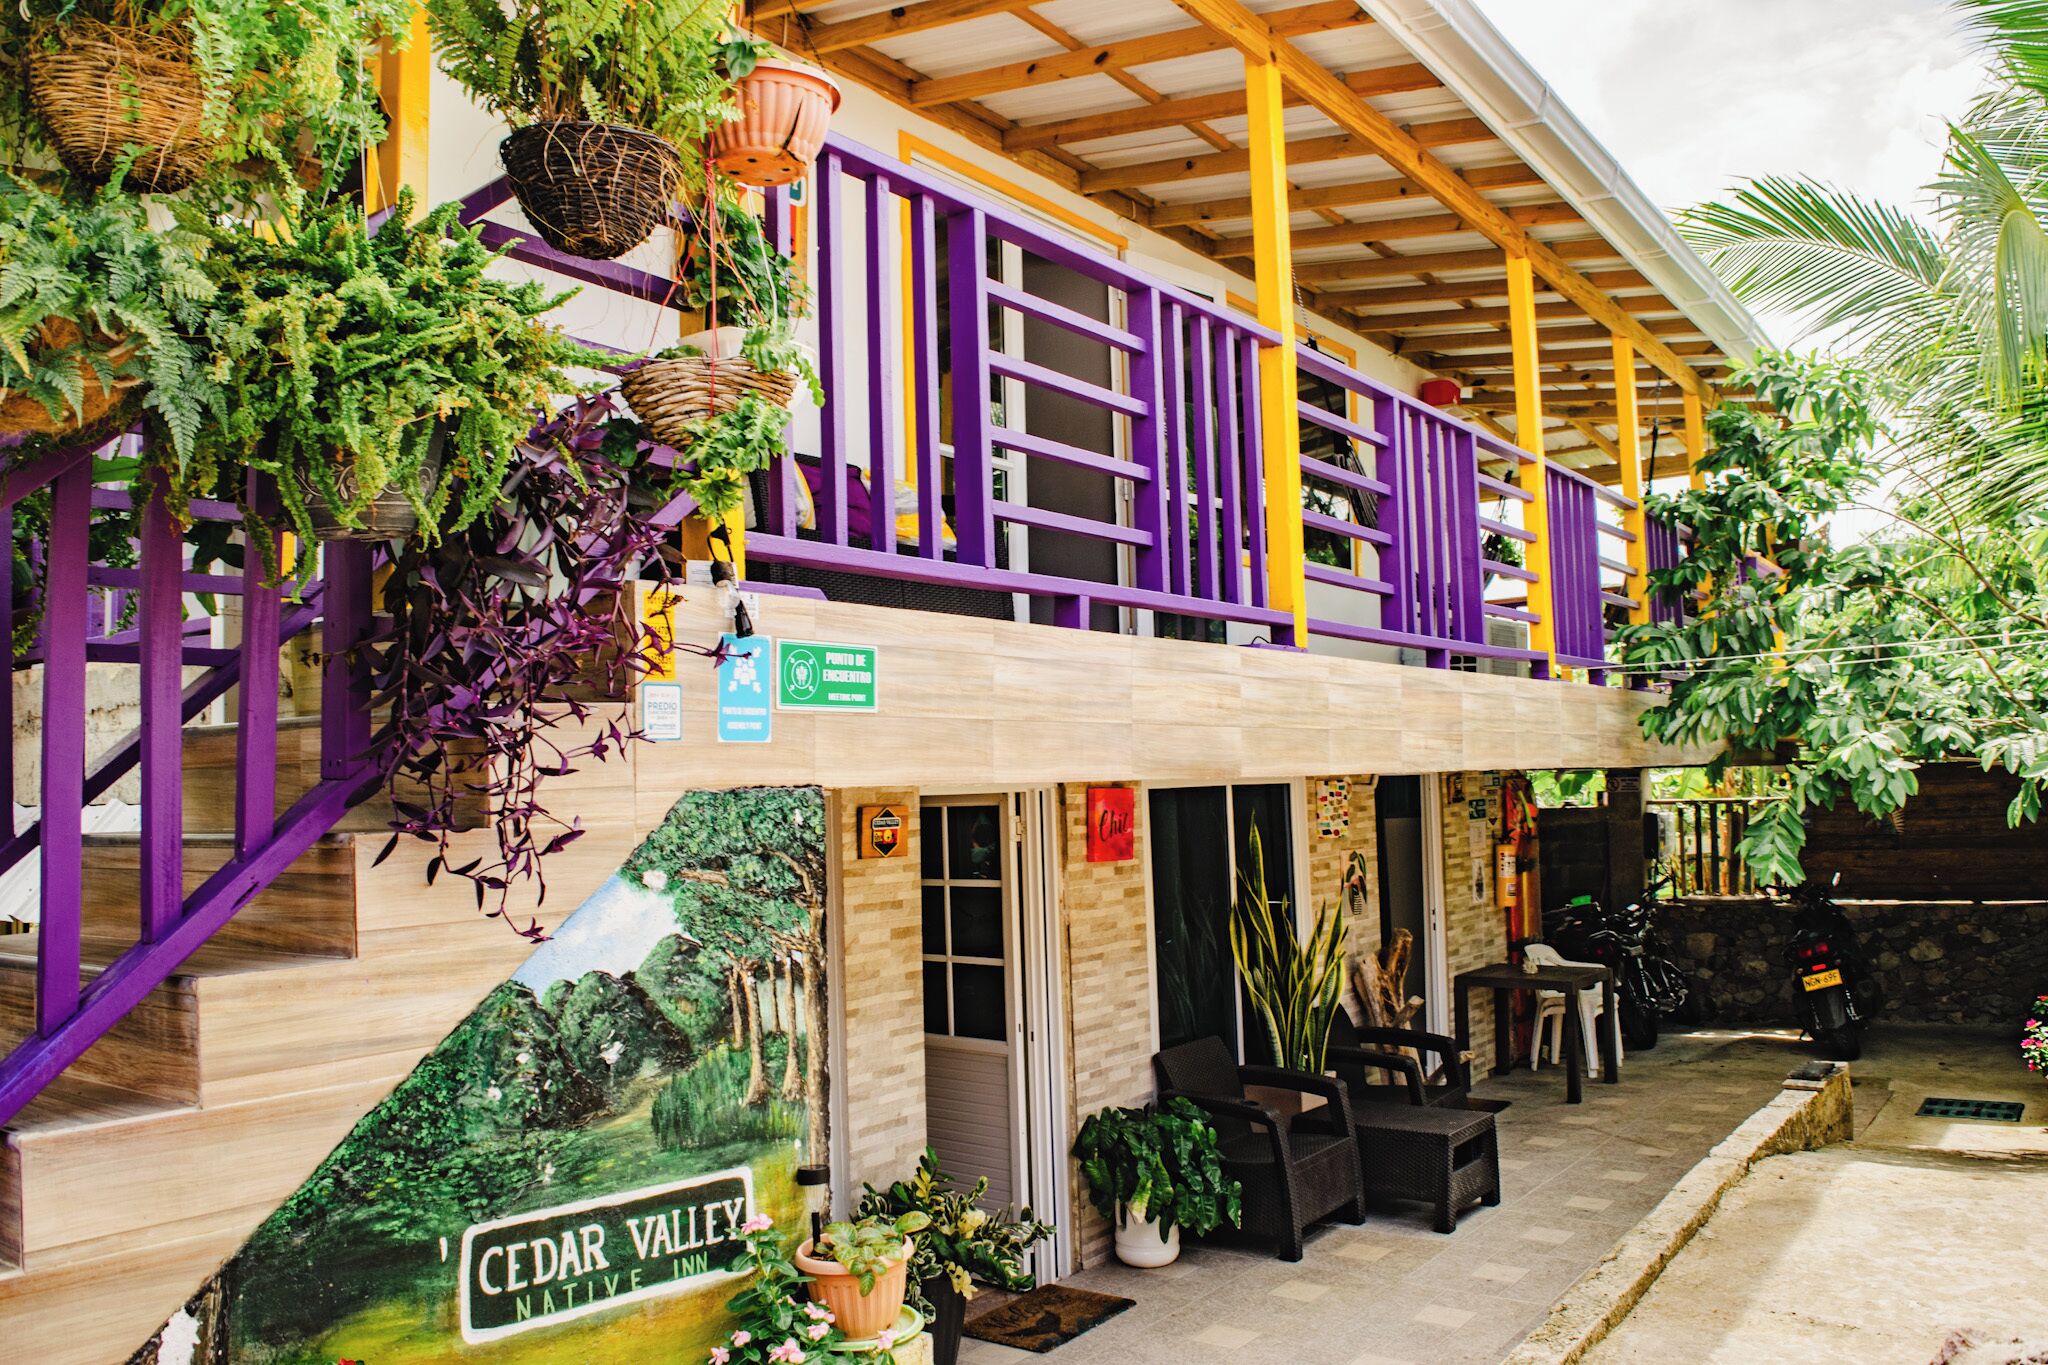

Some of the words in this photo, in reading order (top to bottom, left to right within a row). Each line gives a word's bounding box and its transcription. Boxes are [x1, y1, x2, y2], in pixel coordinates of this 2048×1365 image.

[825, 652, 854, 666] PUNTO
[855, 654, 866, 667] DE
[822, 669, 872, 684] ENCUENTRO
[647, 702, 677, 711] PREDIO
[478, 1223, 610, 1296] CEDAR
[626, 1197, 745, 1260] VALLEY
[515, 1267, 643, 1322] NATIVE
[673, 1250, 708, 1280] INN
